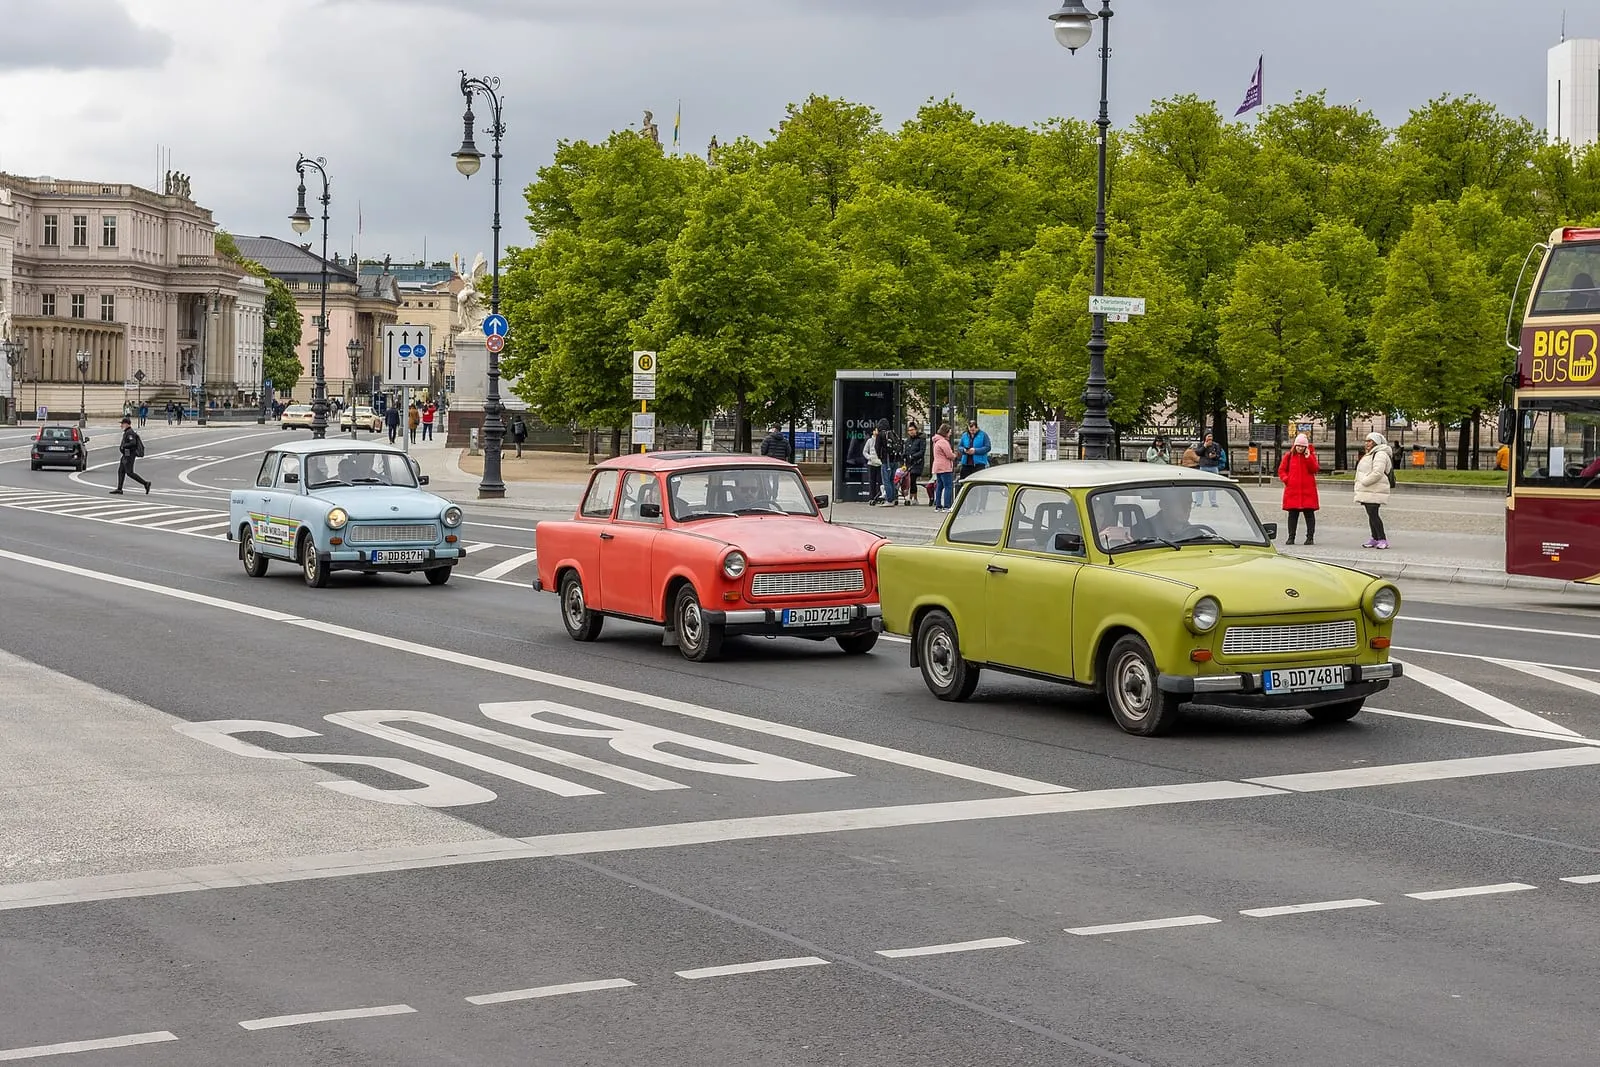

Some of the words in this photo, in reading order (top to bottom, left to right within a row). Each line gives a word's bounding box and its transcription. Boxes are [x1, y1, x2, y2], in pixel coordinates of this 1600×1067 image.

[1534, 330, 1569, 357] BIG
[642, 358, 650, 367] H
[1532, 358, 1568, 382] BUS
[846, 419, 854, 428] O
[378, 552, 384, 560] B
[789, 611, 797, 622] B
[1272, 673, 1281, 687] B
[171, 699, 856, 808] BUS
